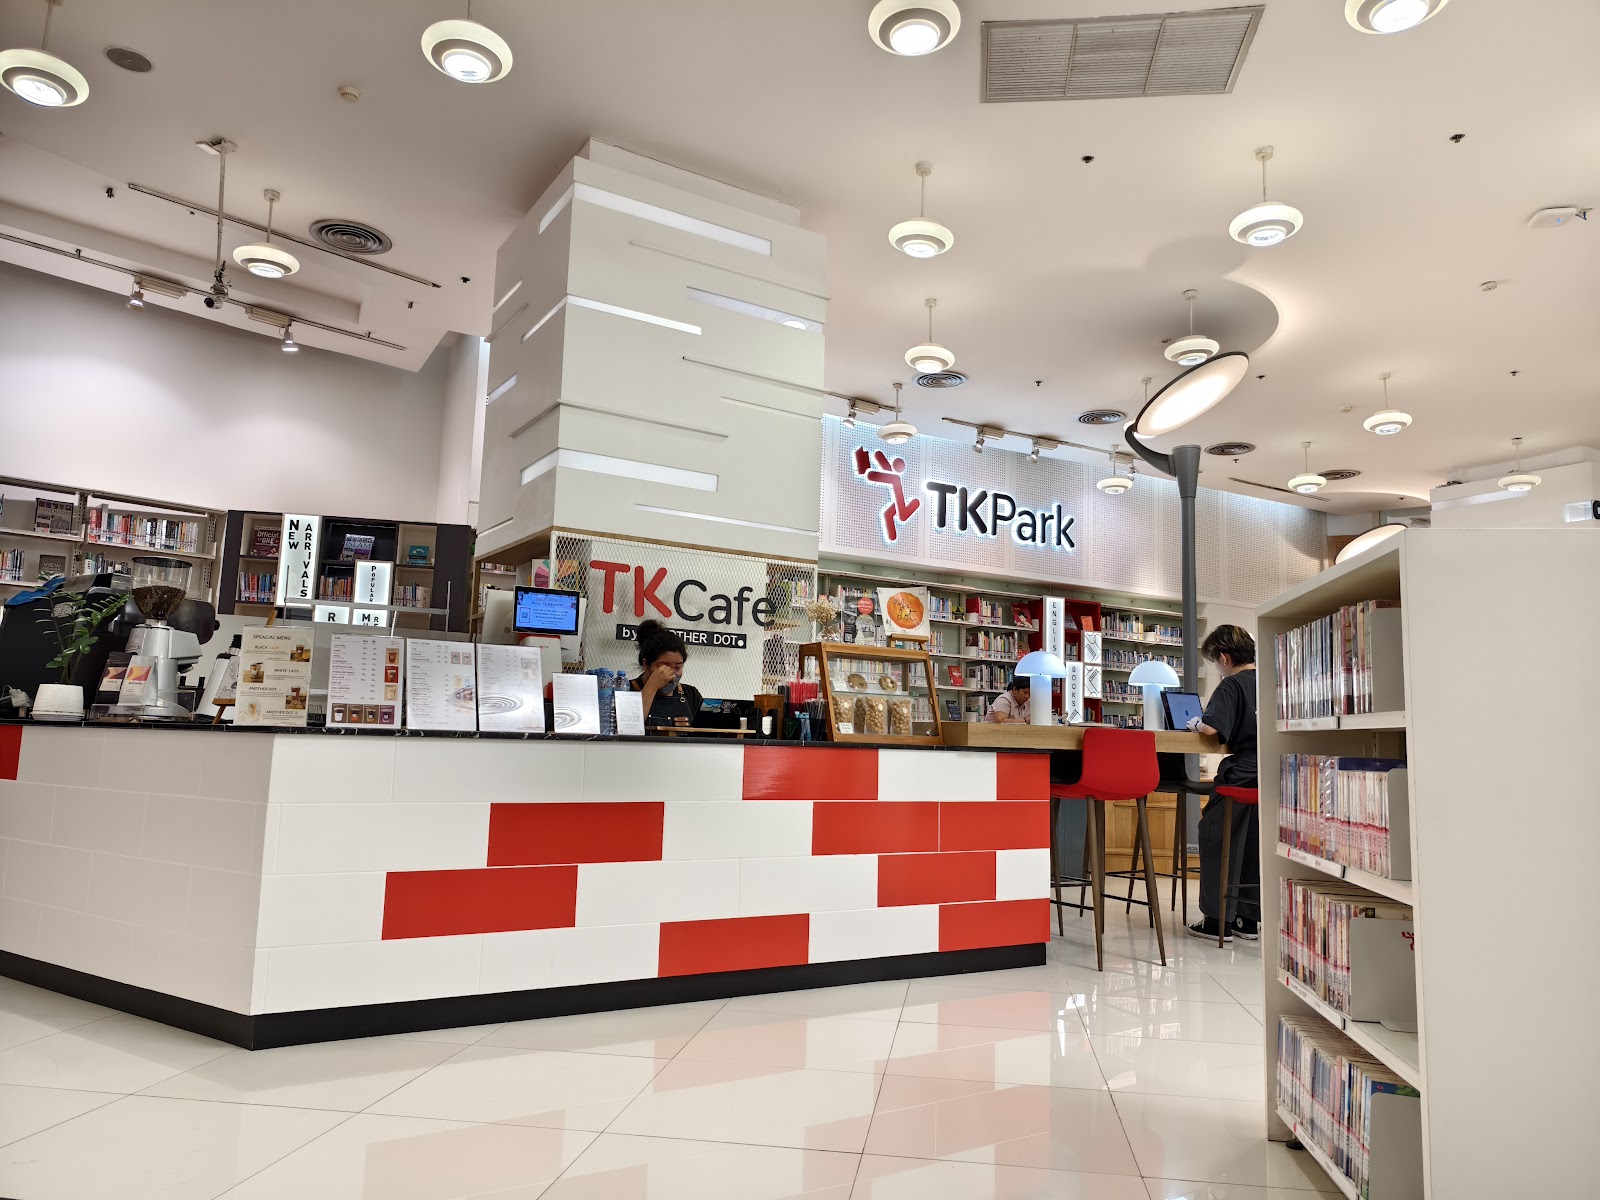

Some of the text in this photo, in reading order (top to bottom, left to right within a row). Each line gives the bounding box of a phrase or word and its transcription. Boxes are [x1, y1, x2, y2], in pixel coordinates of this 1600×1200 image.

[288, 519, 300, 550] NEW
[345, 540, 371, 548] ISLAM
[300, 523, 313, 597] ARRIVALS
[369, 565, 377, 603] POPULAR
[622, 626, 638, 641] by
